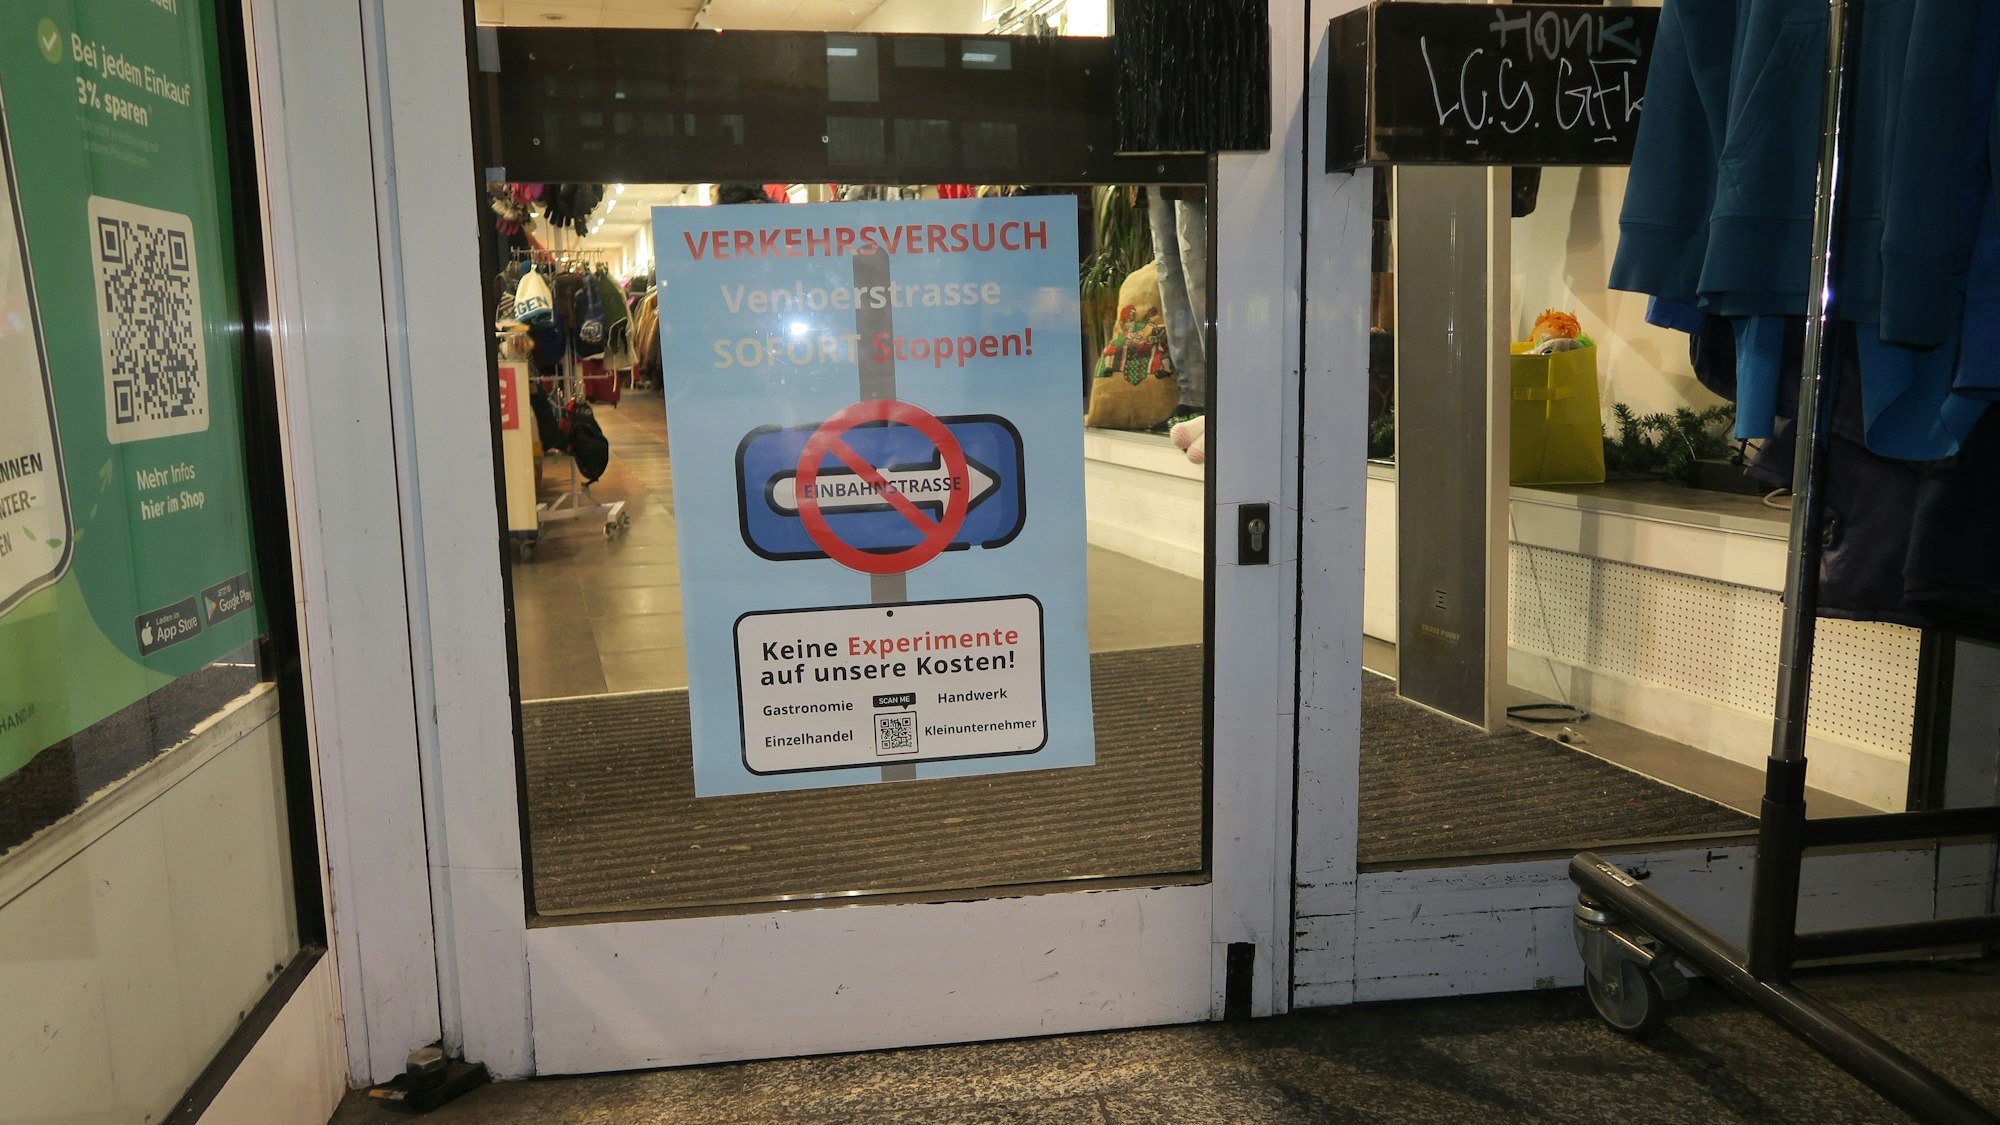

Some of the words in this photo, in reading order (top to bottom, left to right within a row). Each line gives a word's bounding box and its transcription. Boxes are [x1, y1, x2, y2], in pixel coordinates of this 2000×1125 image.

[71, 33, 97, 68] Bei
[101, 46, 142, 87] jedem
[144, 66, 190, 106] Einkauf
[76, 77, 101, 109] 3%
[683, 220, 1048, 260] VERKEHRSVERSUCH
[720, 279, 1000, 314] Venloerstrasse
[713, 333, 861, 369] SOFORT
[872, 327, 1033, 368] Stoppen!
[136, 467, 168, 490] Mehr
[171, 462, 195, 484] Infos
[804, 476, 962, 499] EINBAHNSTRASSE
[141, 499, 165, 520] hier
[167, 495, 179, 513] im
[180, 491, 205, 509] Shop
[220, 593, 240, 612] Google
[239, 589, 252, 603] Play
[157, 626, 177, 642] App
[178, 616, 198, 633] Store
[763, 639, 838, 661] Keine
[848, 628, 1019, 659] Experimente
[761, 664, 805, 686] auf
[814, 662, 906, 682] unsere
[916, 650, 1015, 675] Kosten!
[763, 700, 853, 716] Gastronomie
[879, 697, 898, 705] SCAN
[900, 695, 910, 703] ME
[938, 688, 1008, 704] Handwerk
[765, 730, 853, 747] Einzelhandel
[924, 719, 1037, 736] Kleinunternehmer
